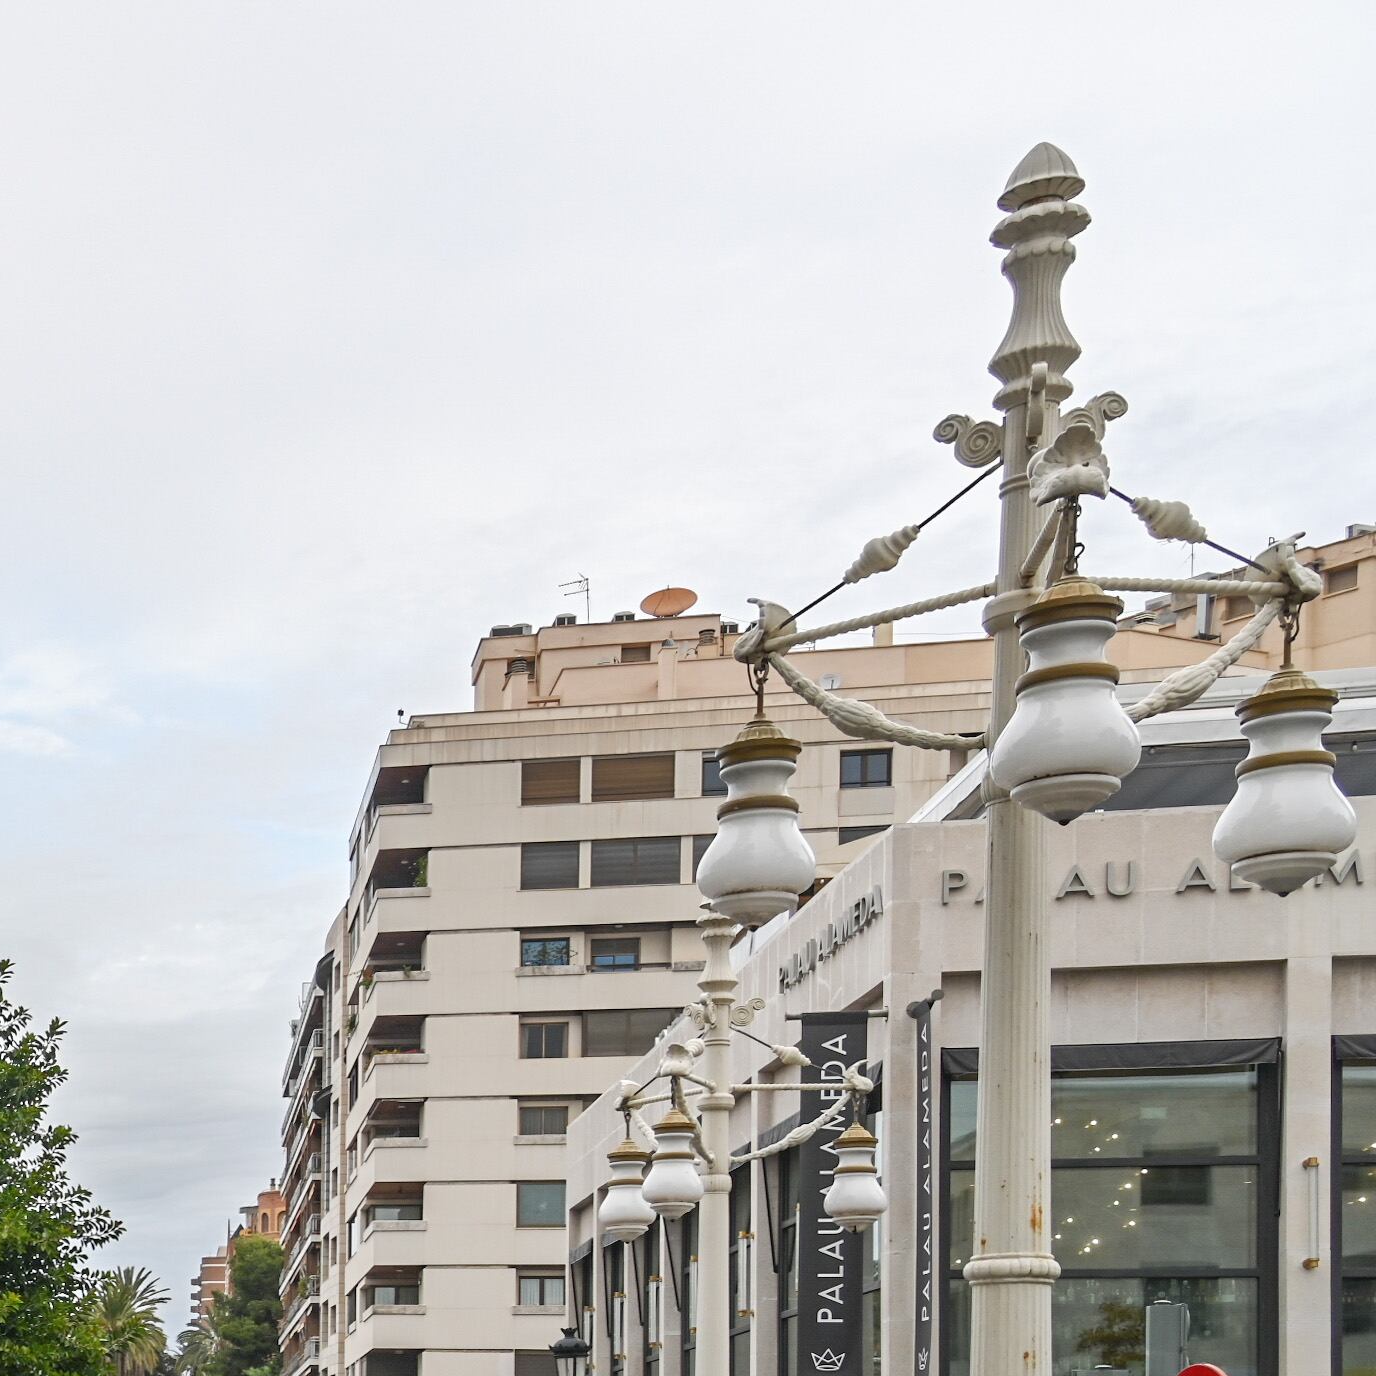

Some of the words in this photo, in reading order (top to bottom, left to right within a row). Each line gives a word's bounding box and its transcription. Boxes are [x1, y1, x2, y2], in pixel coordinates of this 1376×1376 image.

[942, 863, 1136, 906] PAU
[778, 938, 817, 994] PALAU
[817, 885, 883, 962] ALAMEDA
[920, 1023, 931, 1196] ALAMEDA
[816, 1217, 845, 1323] PALAU
[921, 1213, 931, 1322] PALAU
